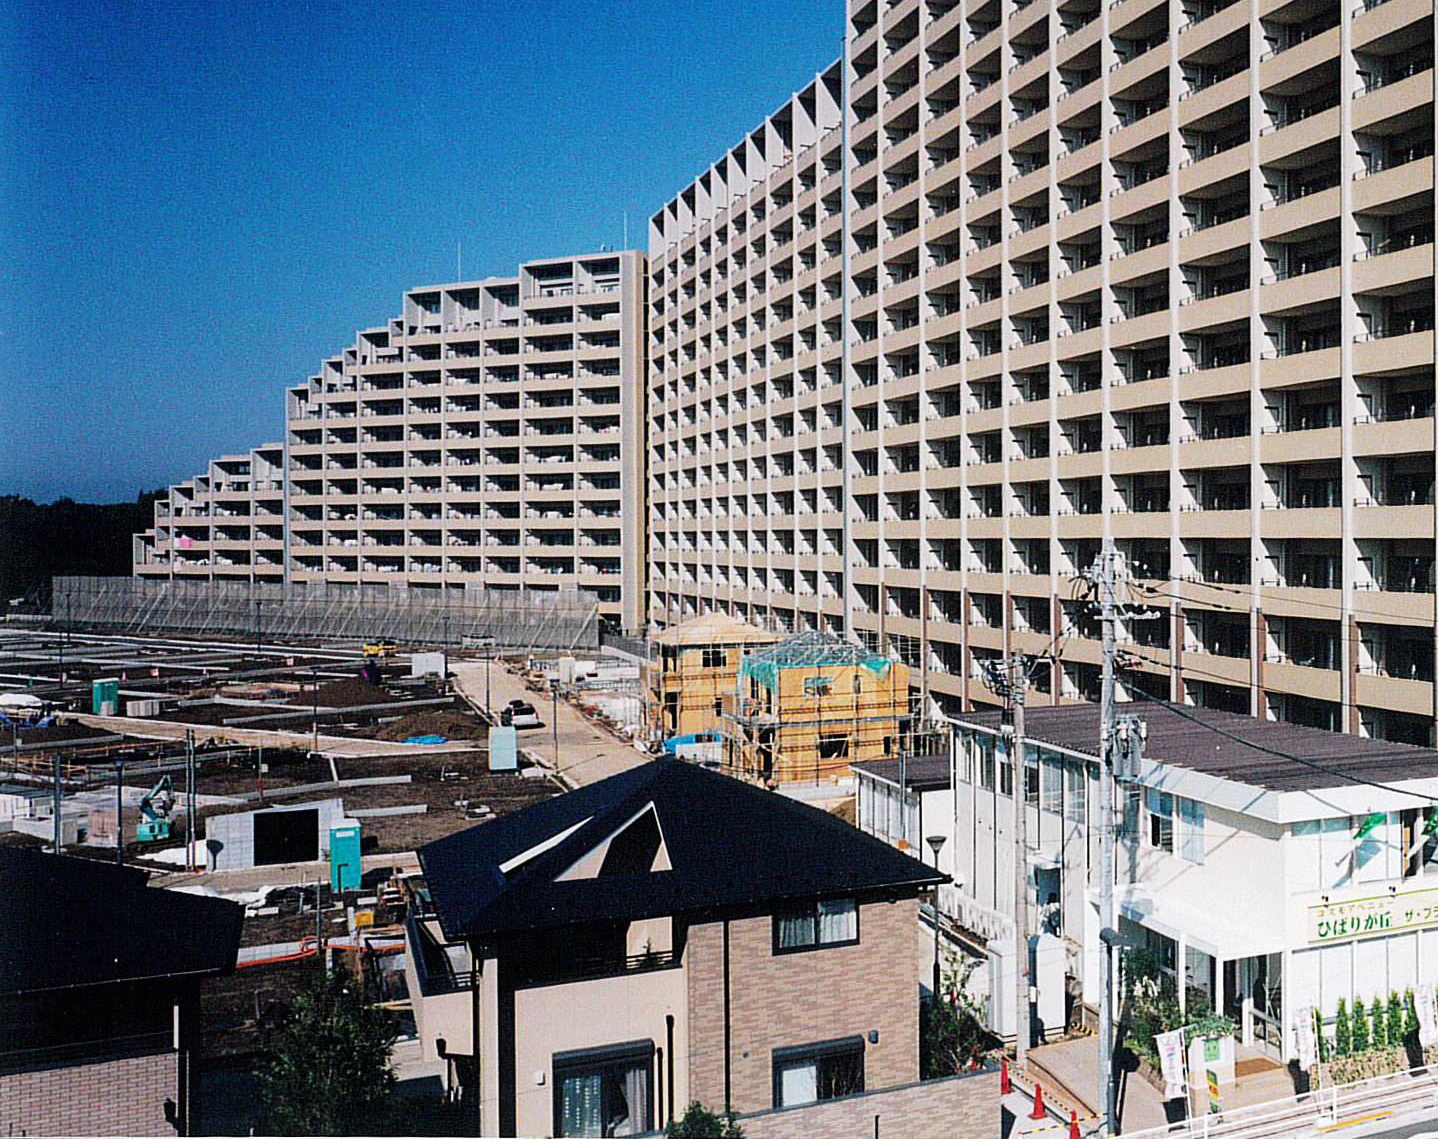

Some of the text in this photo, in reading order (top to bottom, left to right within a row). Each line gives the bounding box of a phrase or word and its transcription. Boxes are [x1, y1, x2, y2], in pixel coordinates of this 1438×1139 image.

[1317, 911, 1394, 937] ひばりが丘
